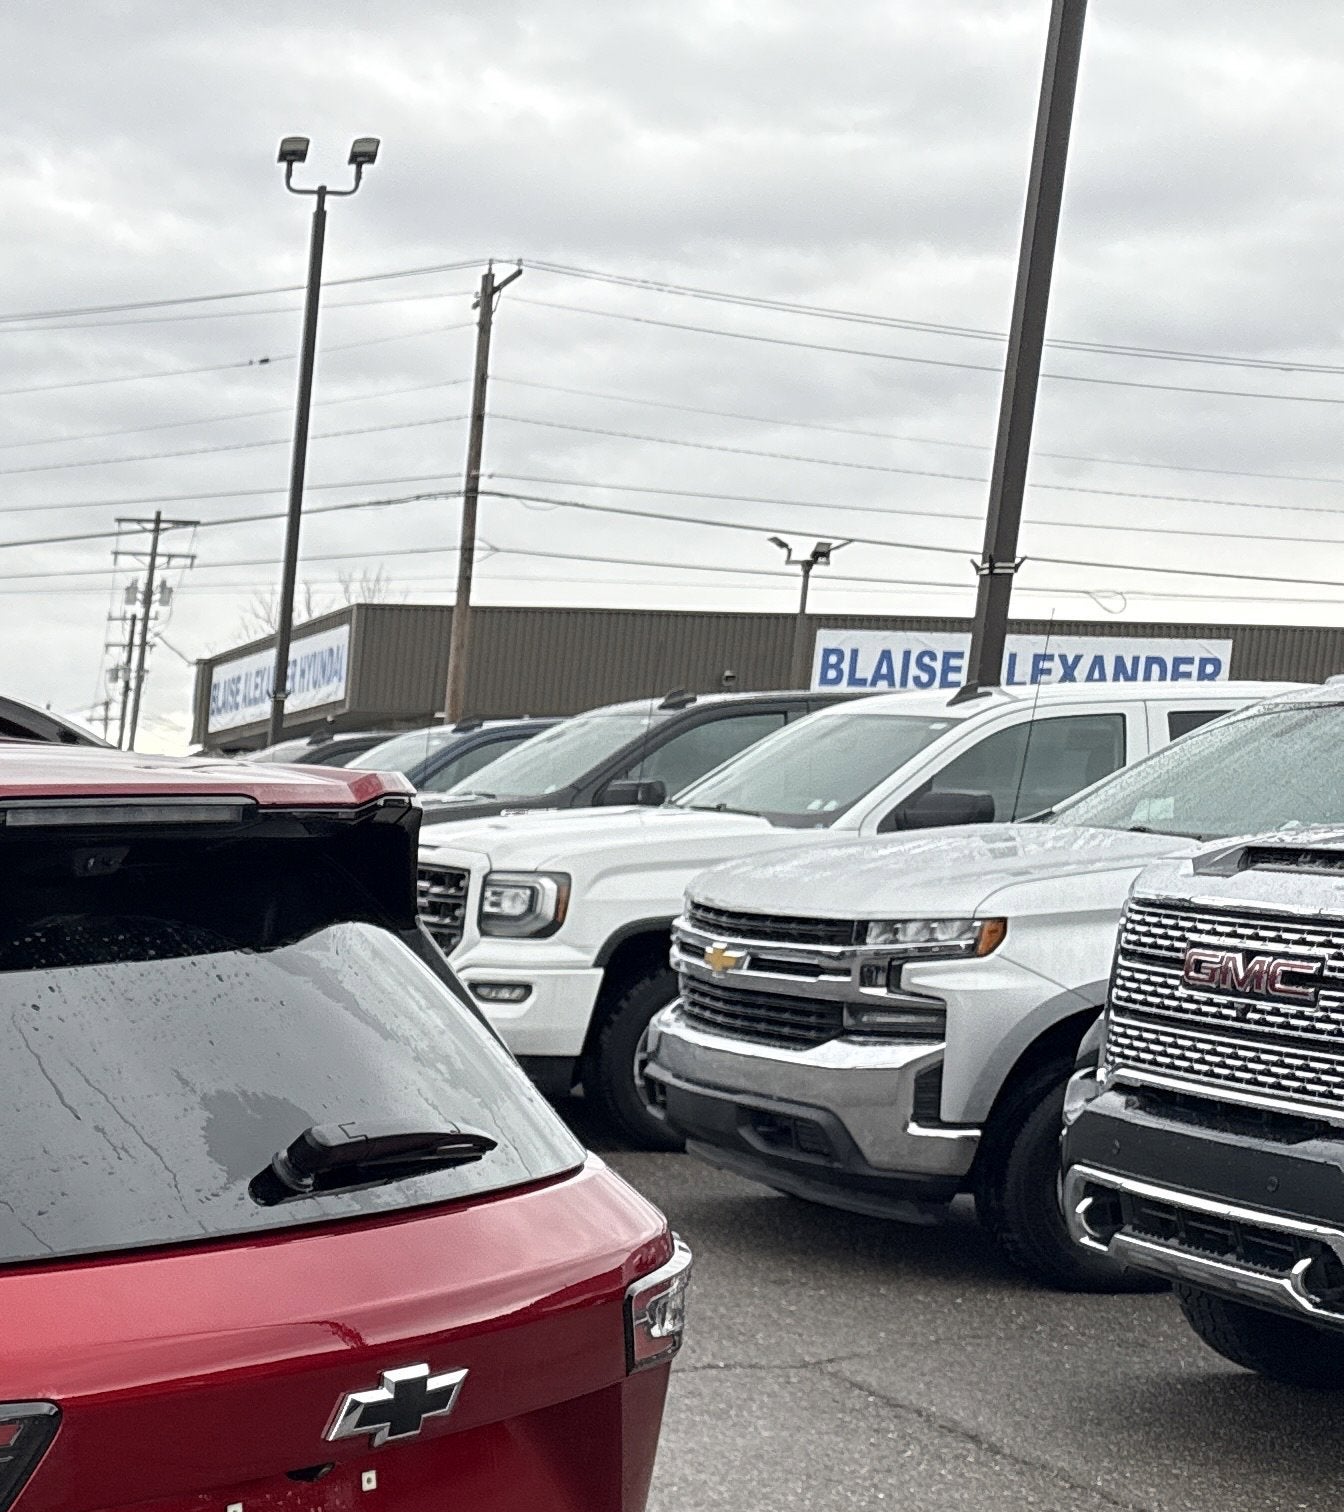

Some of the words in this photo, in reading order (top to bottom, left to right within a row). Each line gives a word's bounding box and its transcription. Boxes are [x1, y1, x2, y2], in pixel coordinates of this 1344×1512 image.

[298, 643, 345, 694] HYUNDAI
[818, 647, 965, 690] BLAISE
[1005, 652, 1222, 686] LEXANDER
[1184, 948, 1322, 1001] GMC
